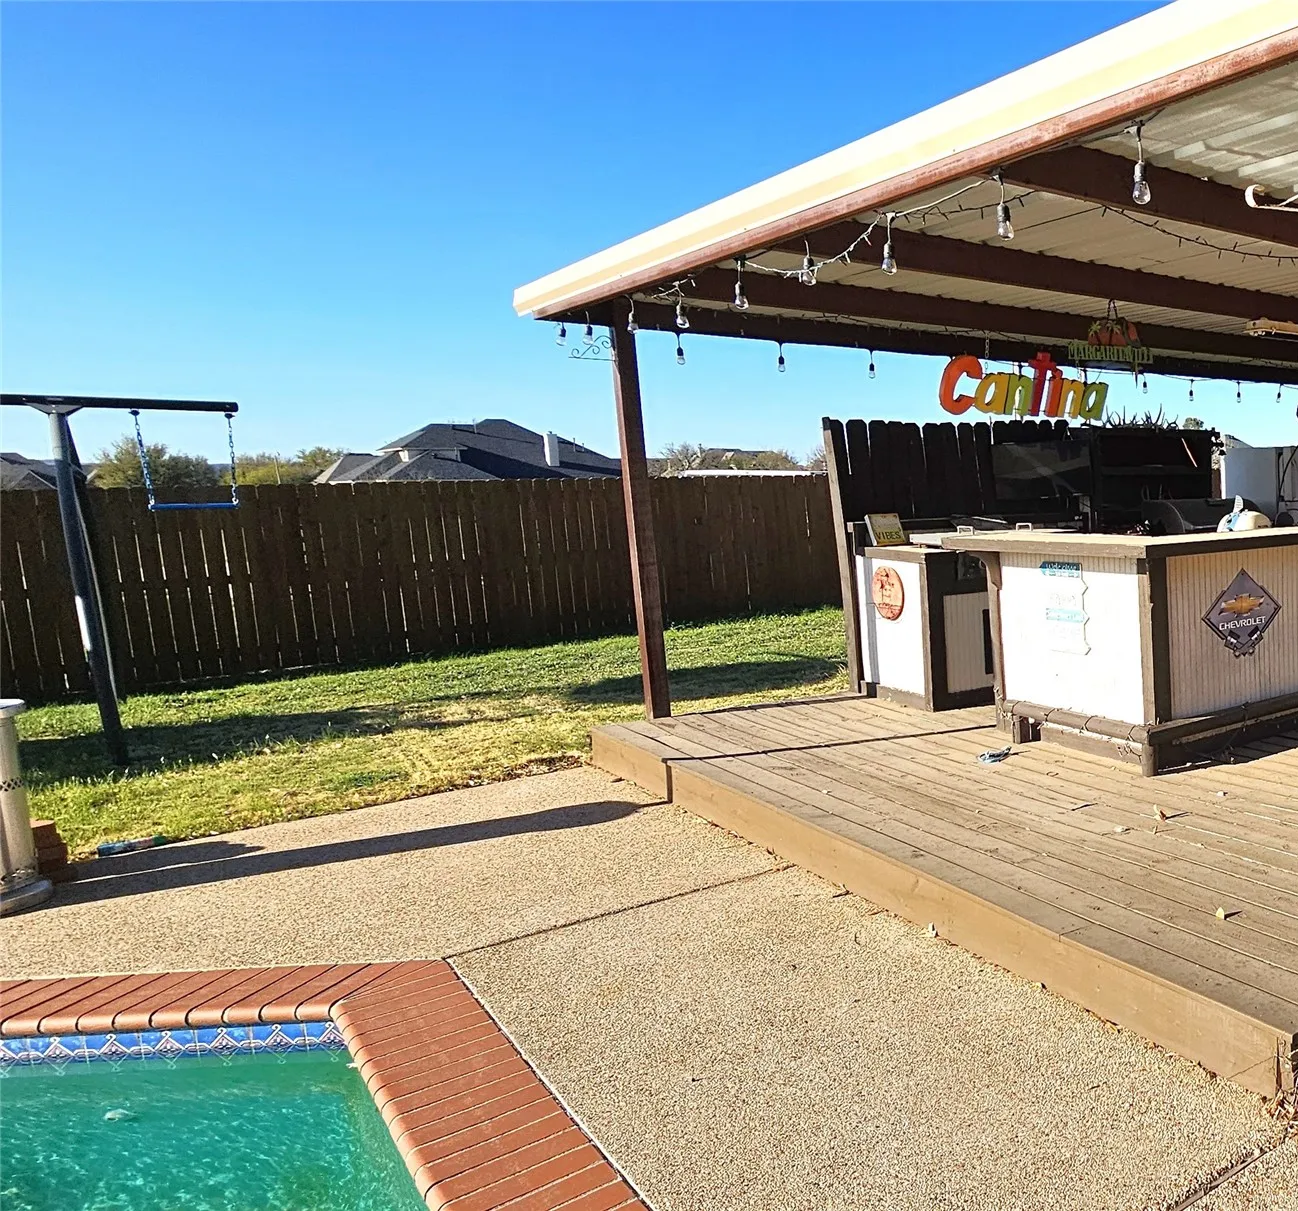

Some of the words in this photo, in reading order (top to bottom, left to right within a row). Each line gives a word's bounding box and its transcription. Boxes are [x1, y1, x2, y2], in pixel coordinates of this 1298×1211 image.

[939, 351, 1109, 420] Cantina
[875, 531, 902, 540] VIBES
[1219, 616, 1266, 630] CHEVROLET
